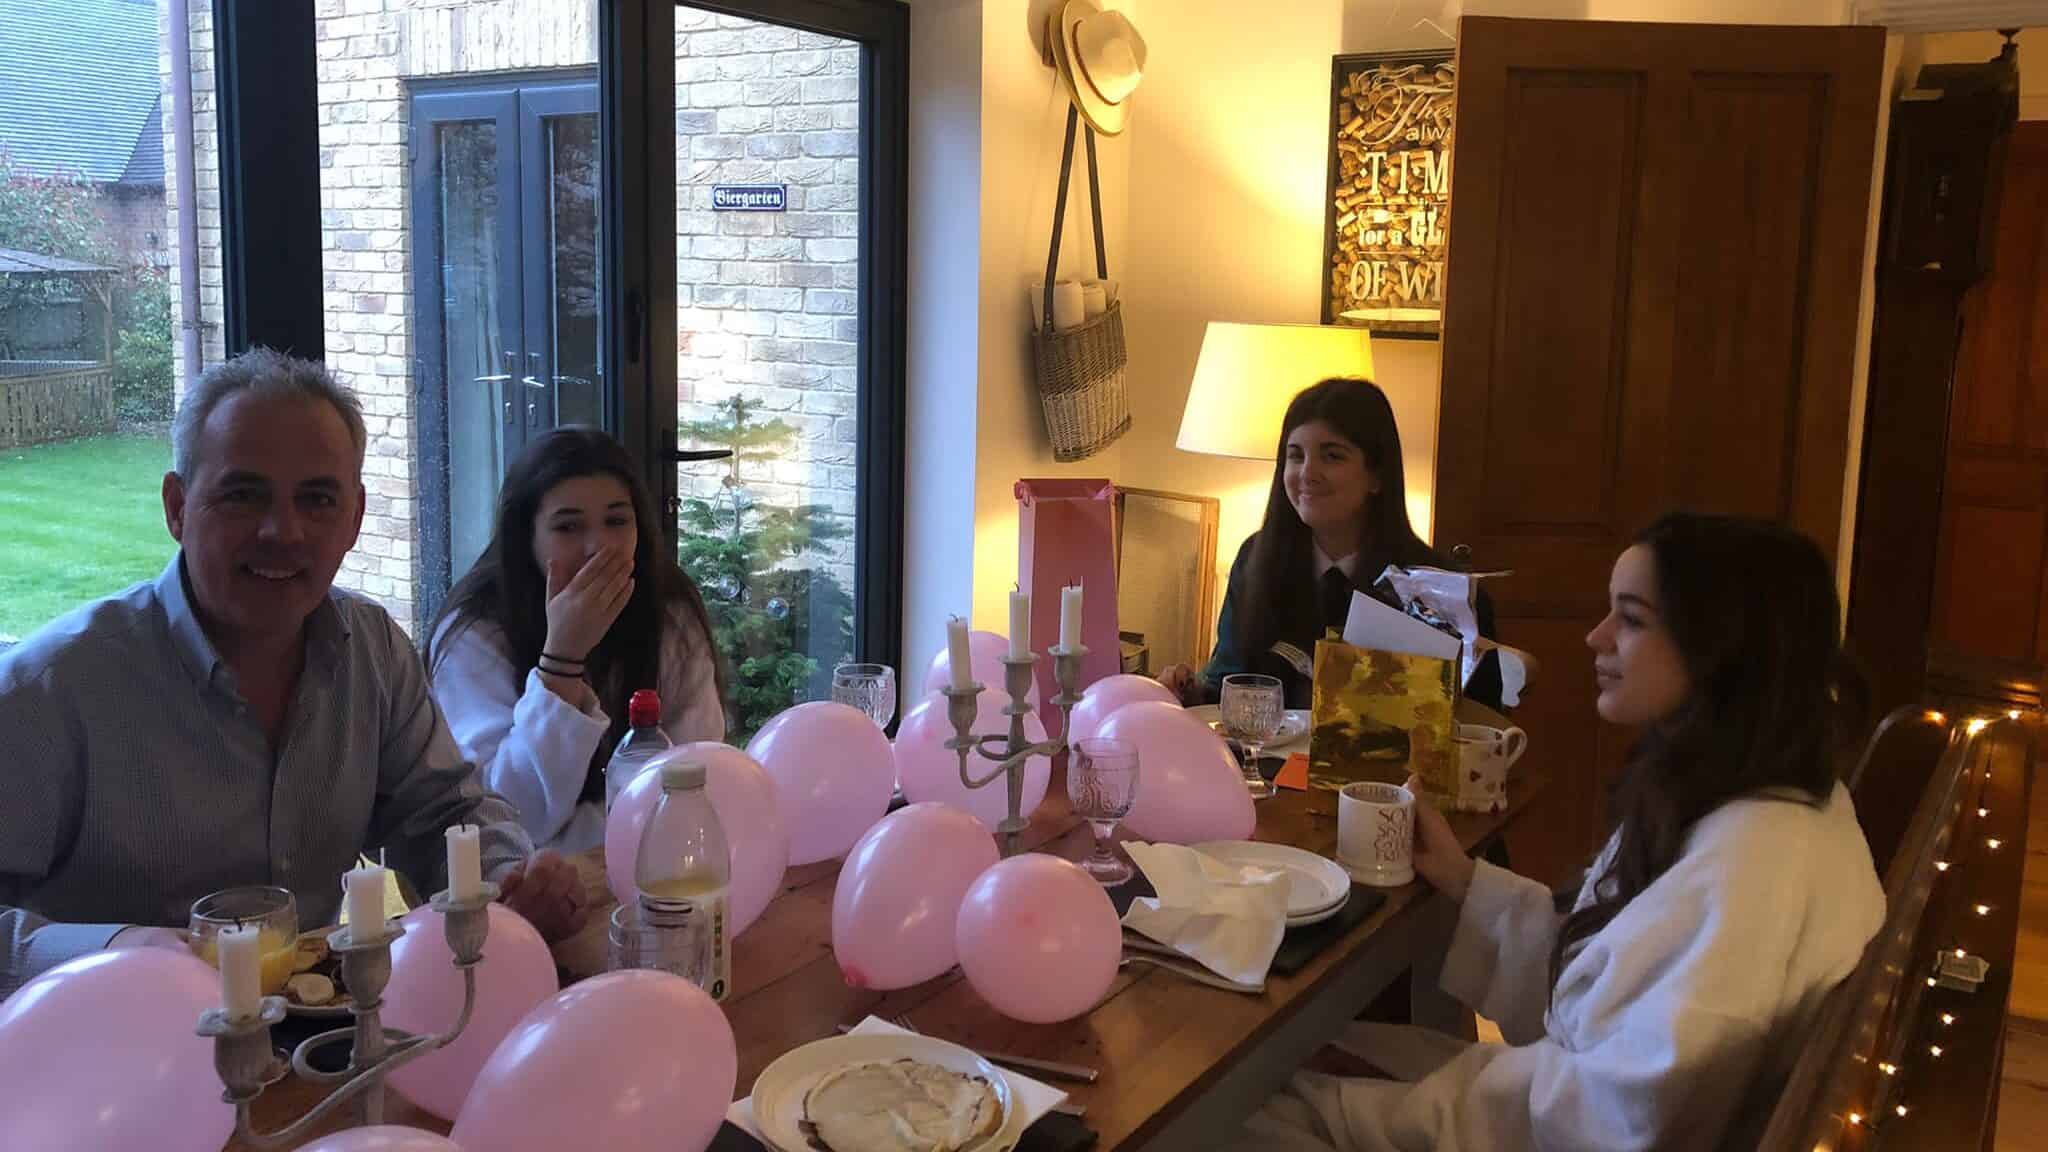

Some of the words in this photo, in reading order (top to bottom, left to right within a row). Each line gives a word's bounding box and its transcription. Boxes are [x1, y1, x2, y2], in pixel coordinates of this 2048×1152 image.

[1358, 64, 1453, 144] The
[1367, 150, 1450, 195] TIM
[715, 189, 780, 208] Biergarten
[1411, 206, 1443, 246] GL
[1350, 260, 1388, 301] OF
[1400, 260, 1443, 302] WI
